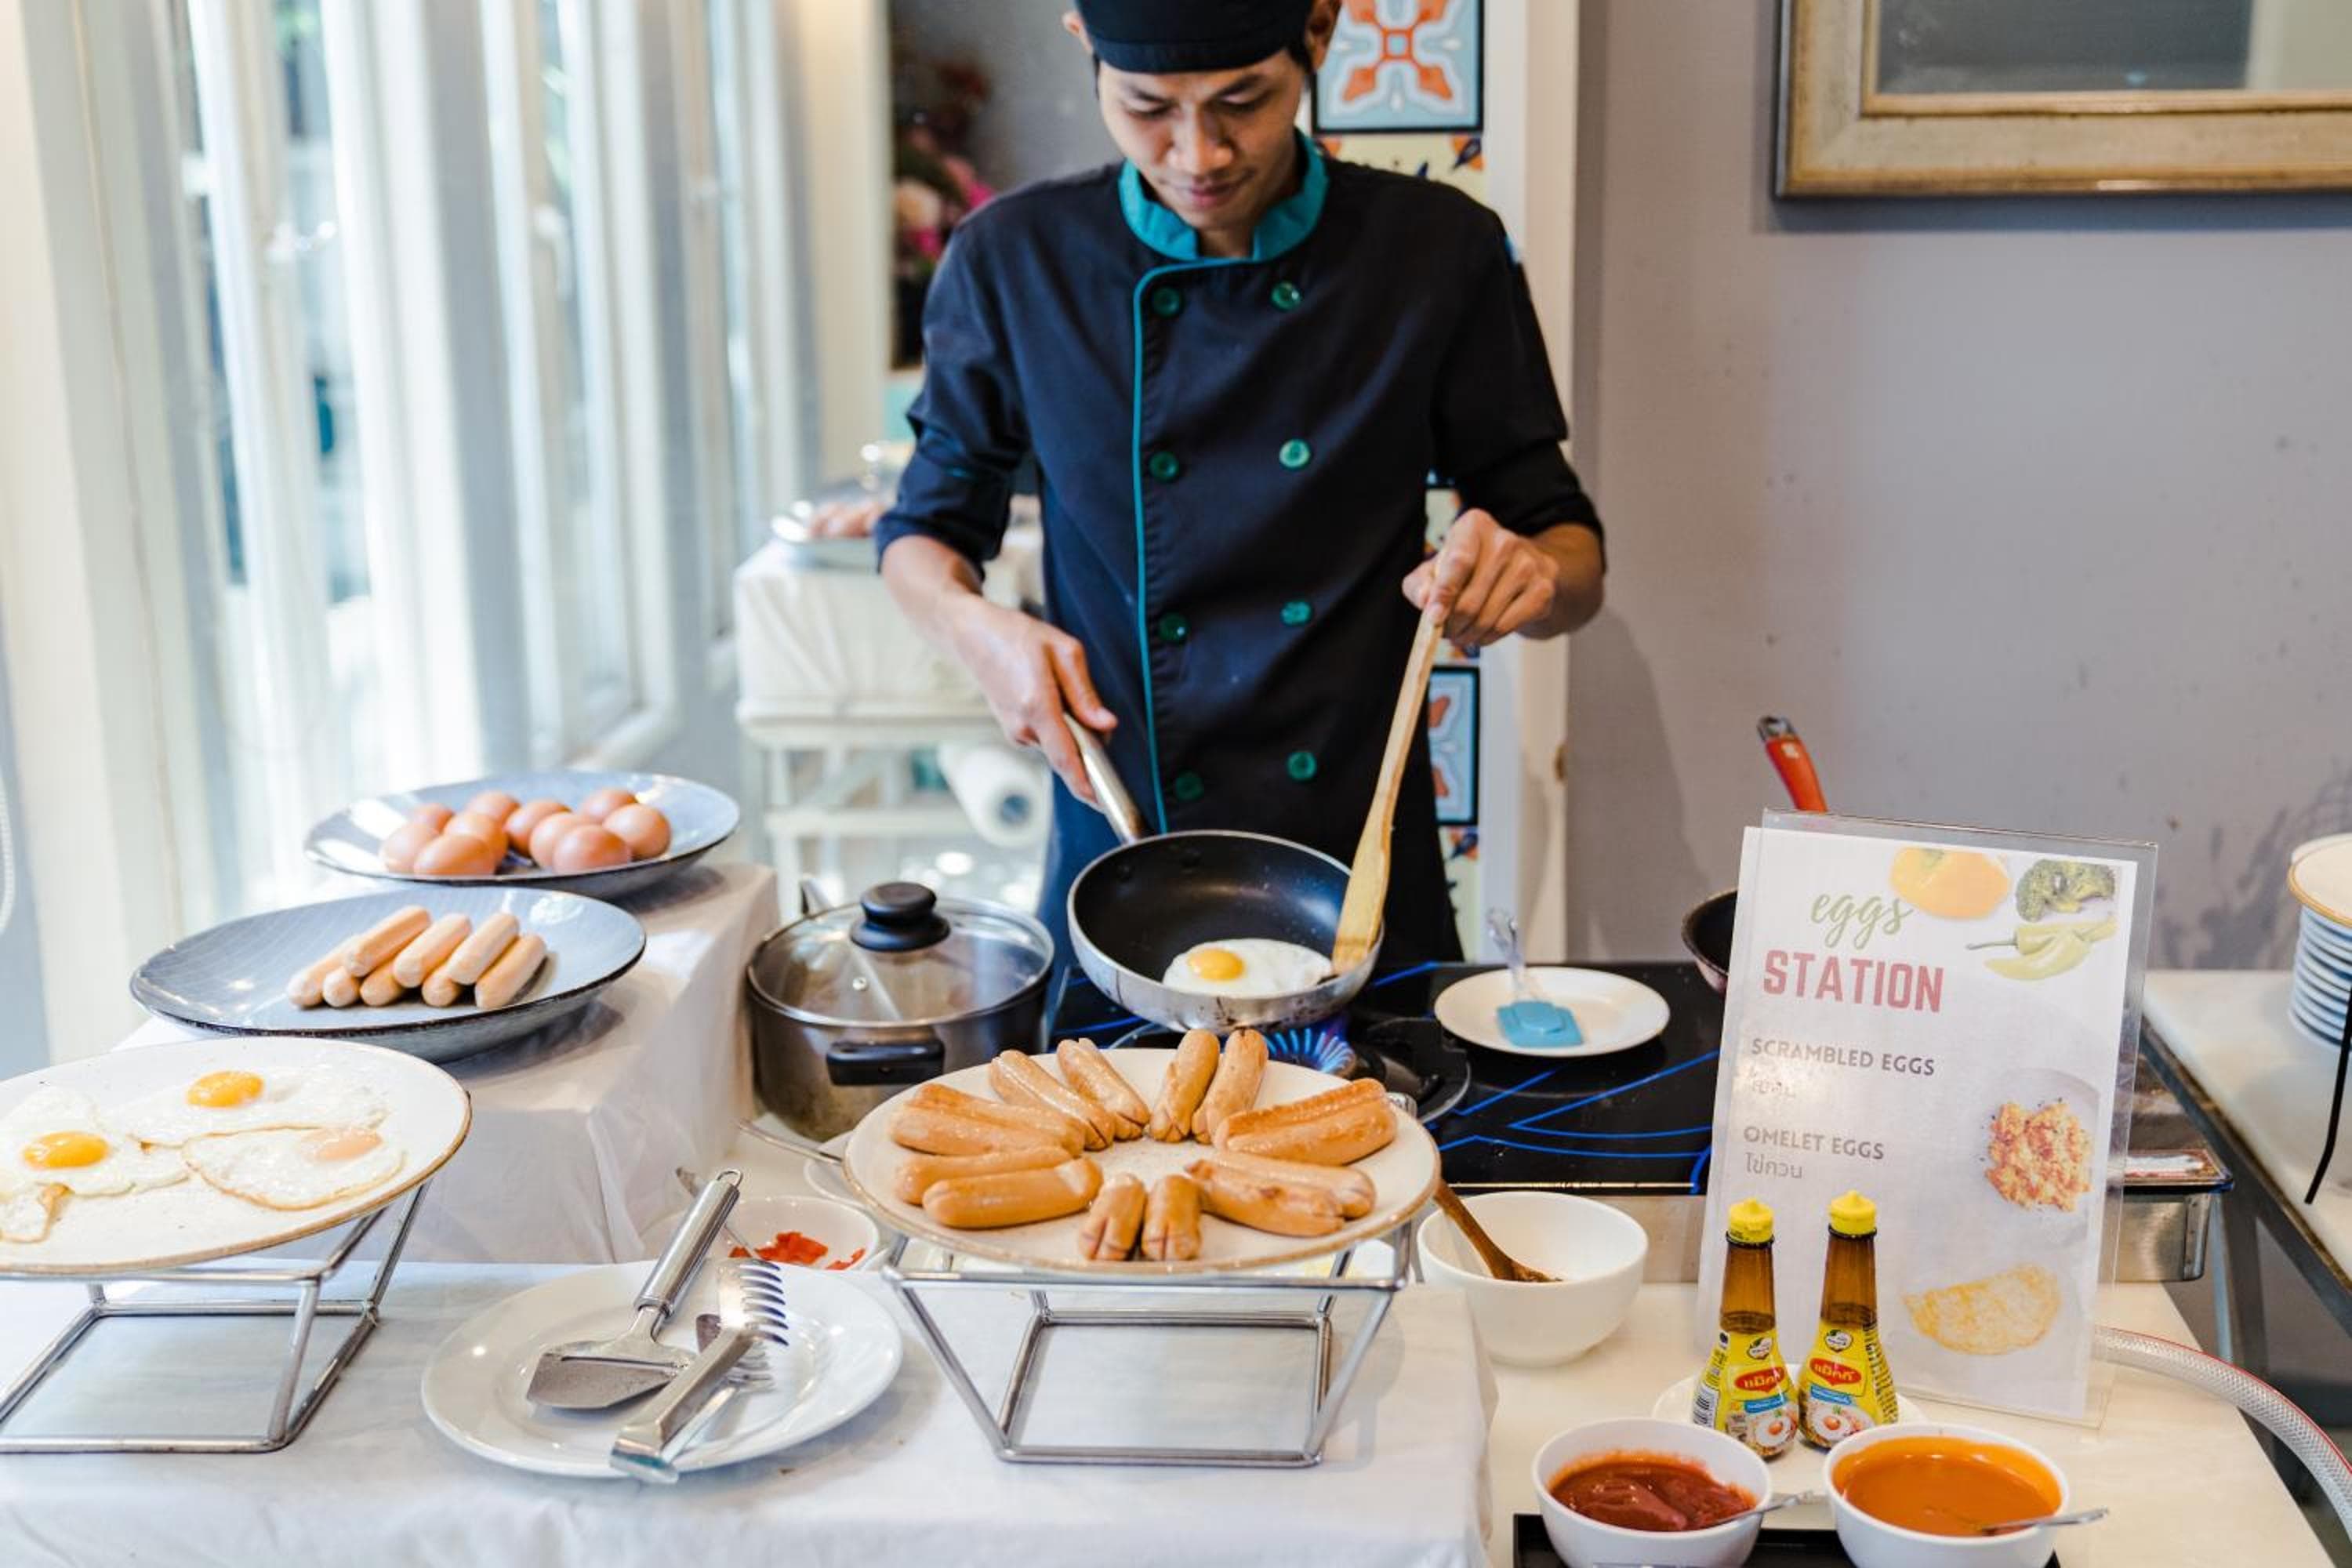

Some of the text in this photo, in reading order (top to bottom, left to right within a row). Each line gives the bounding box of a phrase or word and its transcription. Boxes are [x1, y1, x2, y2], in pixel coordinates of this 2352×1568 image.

[1810, 892, 1914, 950] eggs
[1763, 949, 1944, 1014] STATION
[1751, 1038, 1936, 1076] SCRAMBLED EGGS
[1743, 1125, 1885, 1160] OMELET EGGS
